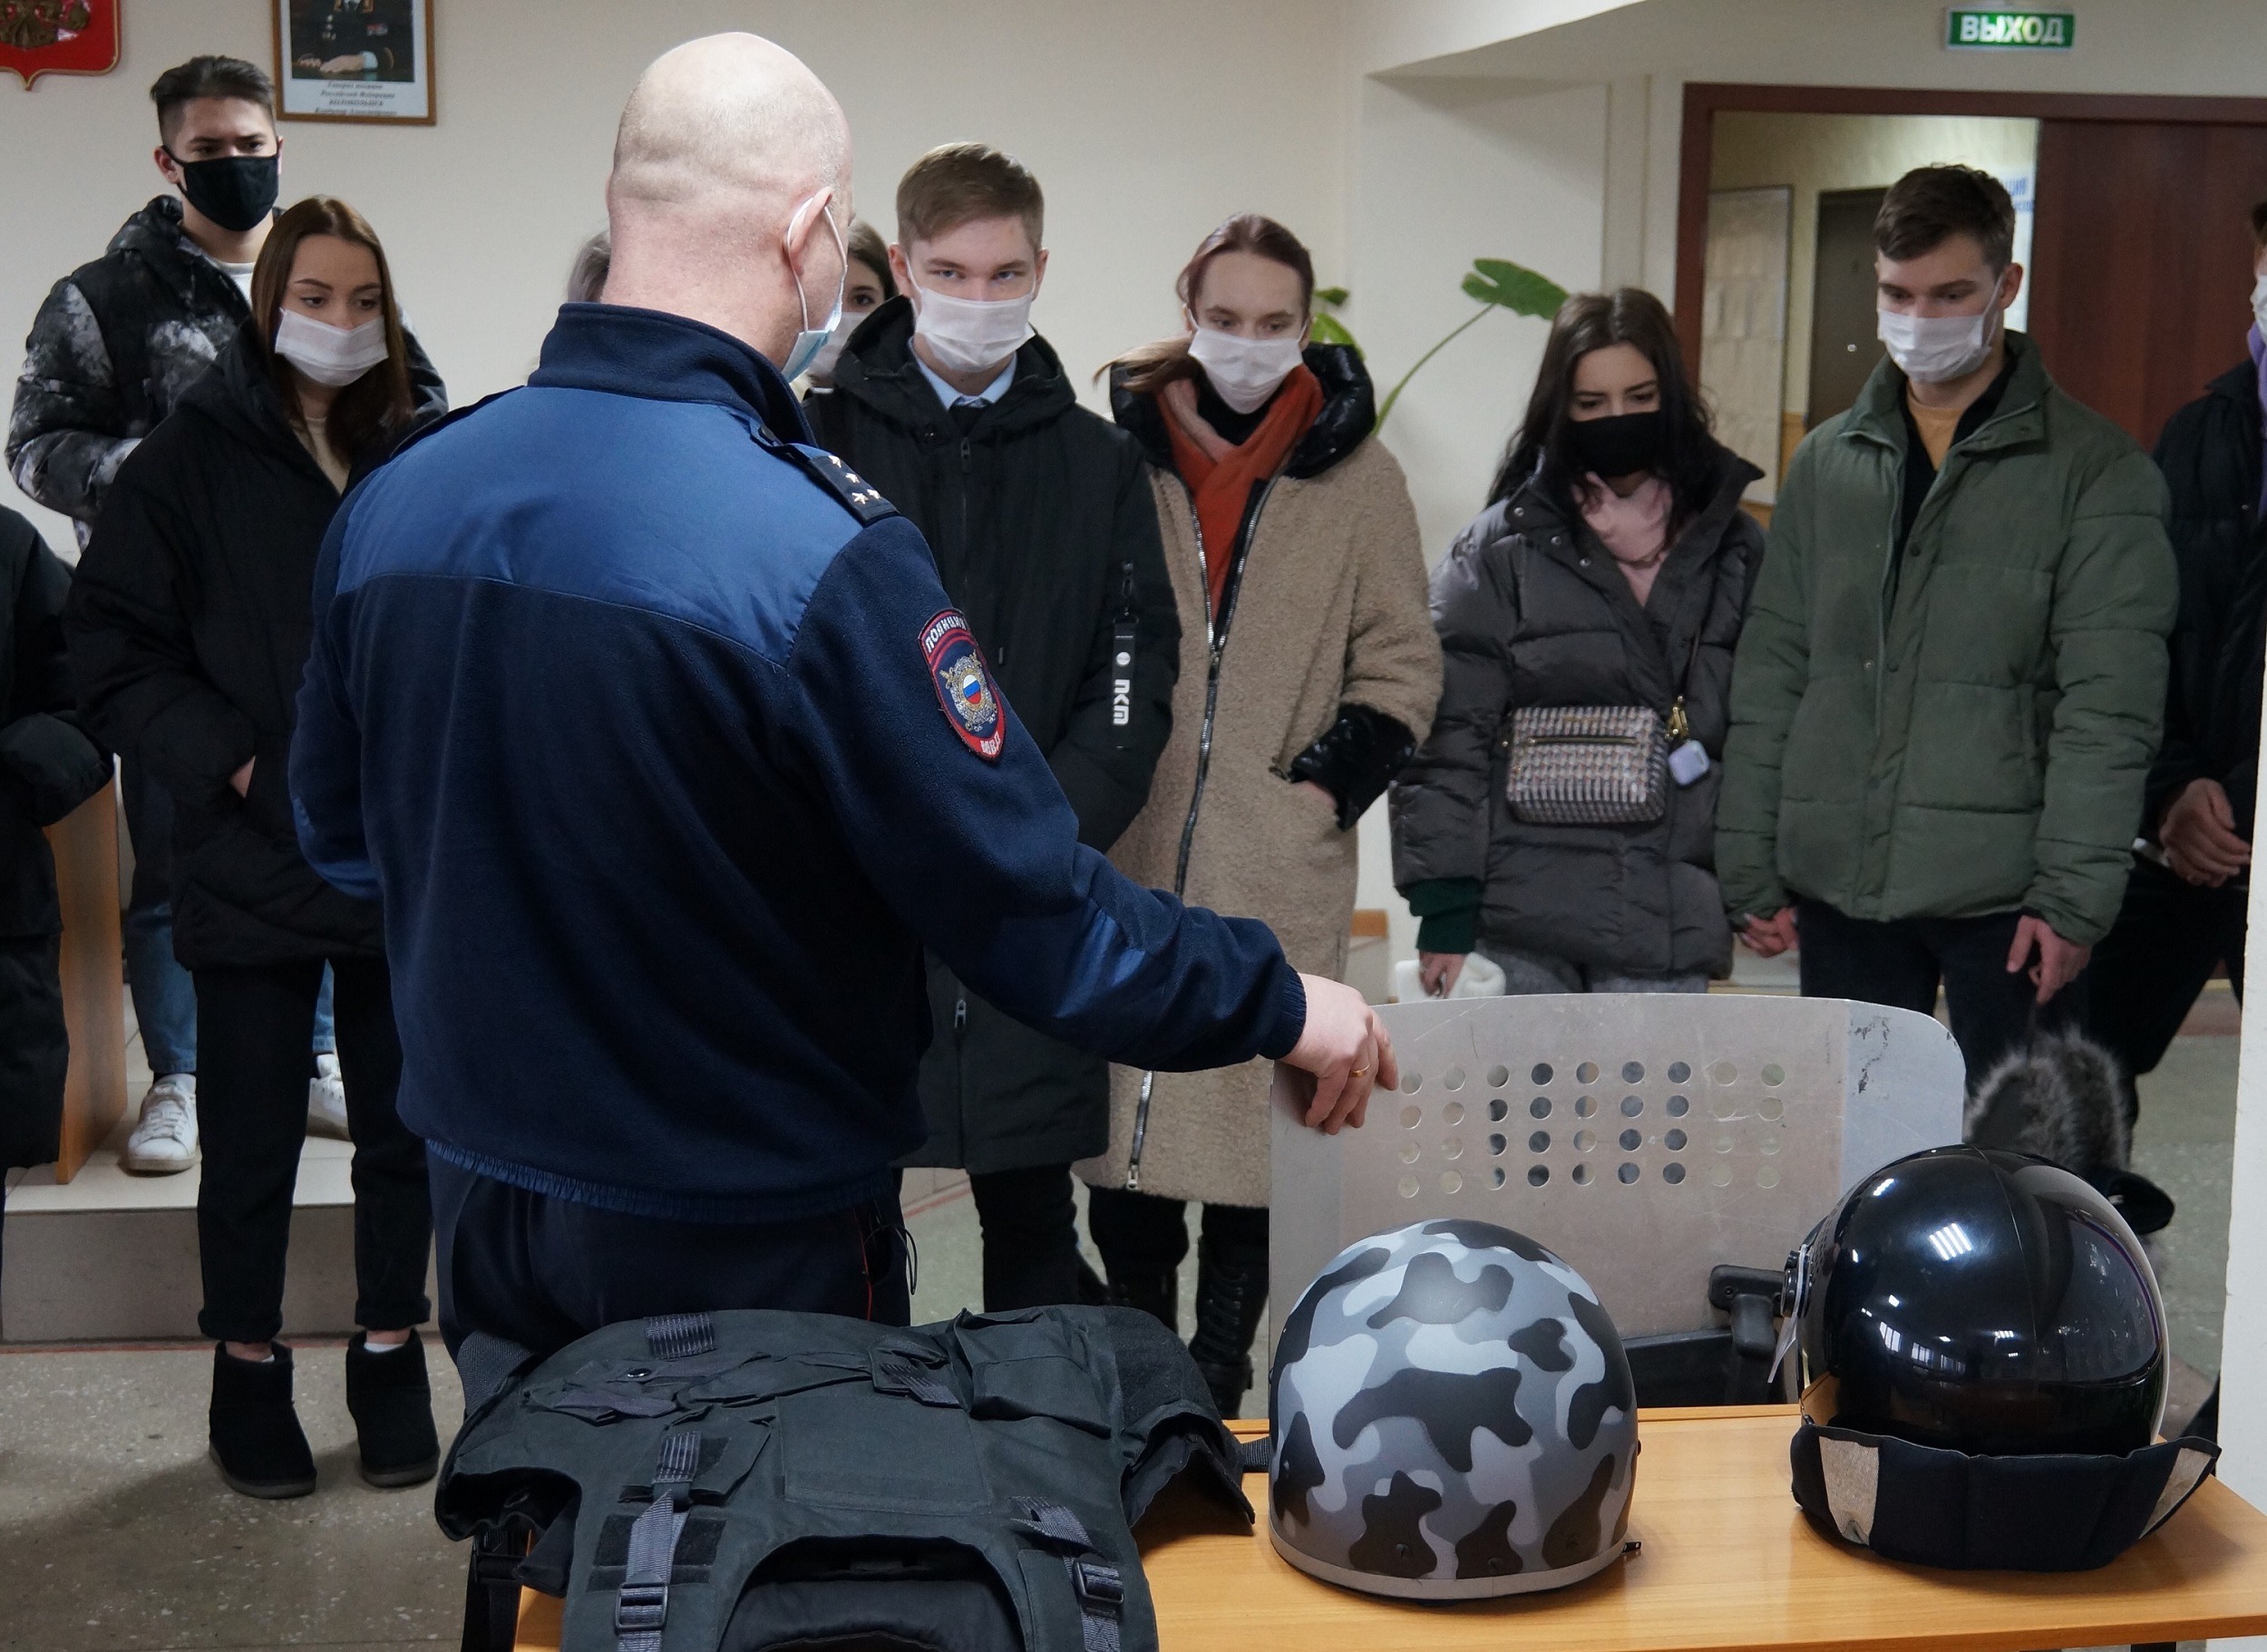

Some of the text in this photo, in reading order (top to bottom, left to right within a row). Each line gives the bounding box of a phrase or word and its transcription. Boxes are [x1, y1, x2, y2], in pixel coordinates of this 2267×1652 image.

[1960, 15, 2064, 45] ВЫХОД
[925, 615, 967, 653] ПОЛИЦИЯ
[980, 730, 1001, 755] МВД
